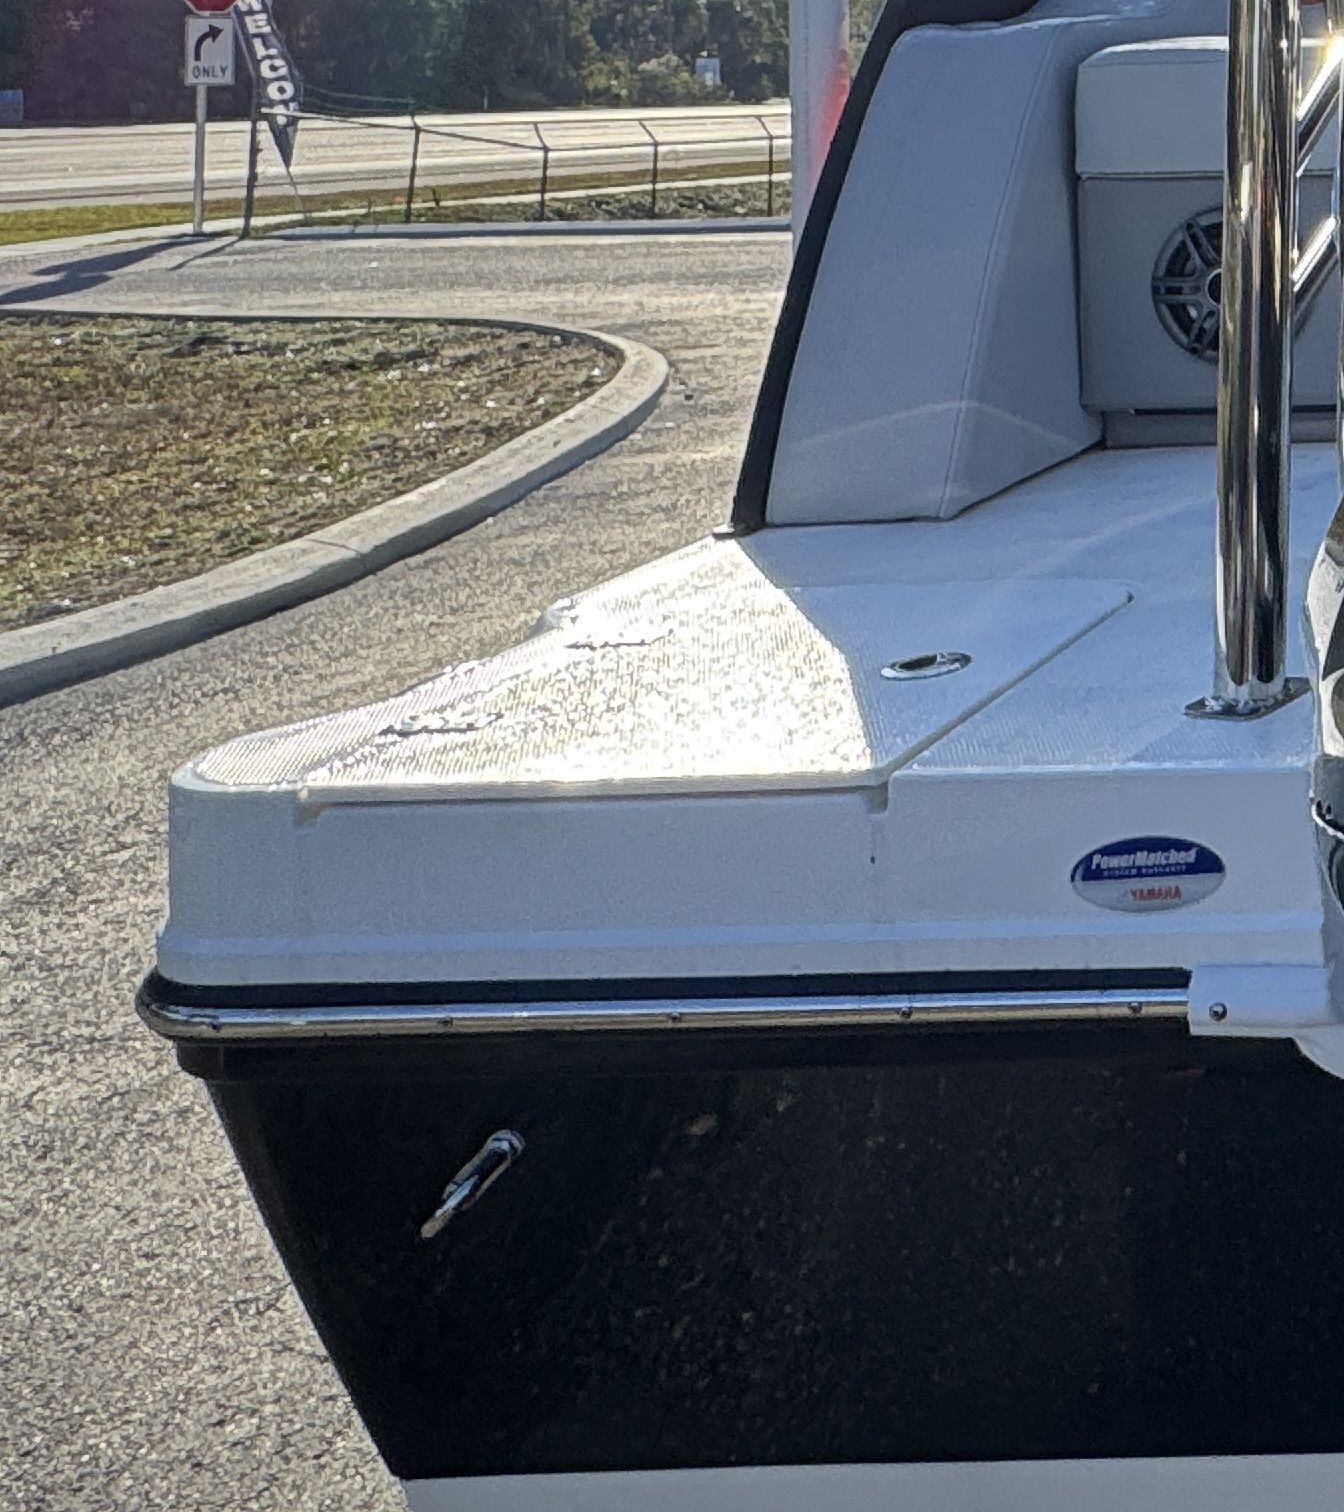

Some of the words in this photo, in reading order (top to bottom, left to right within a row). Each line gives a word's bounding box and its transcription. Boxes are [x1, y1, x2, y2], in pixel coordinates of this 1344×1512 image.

[192, 64, 228, 78] ONLY
[1091, 847, 1198, 870] PowerMatched
[1130, 886, 1182, 901] YAMAHA
